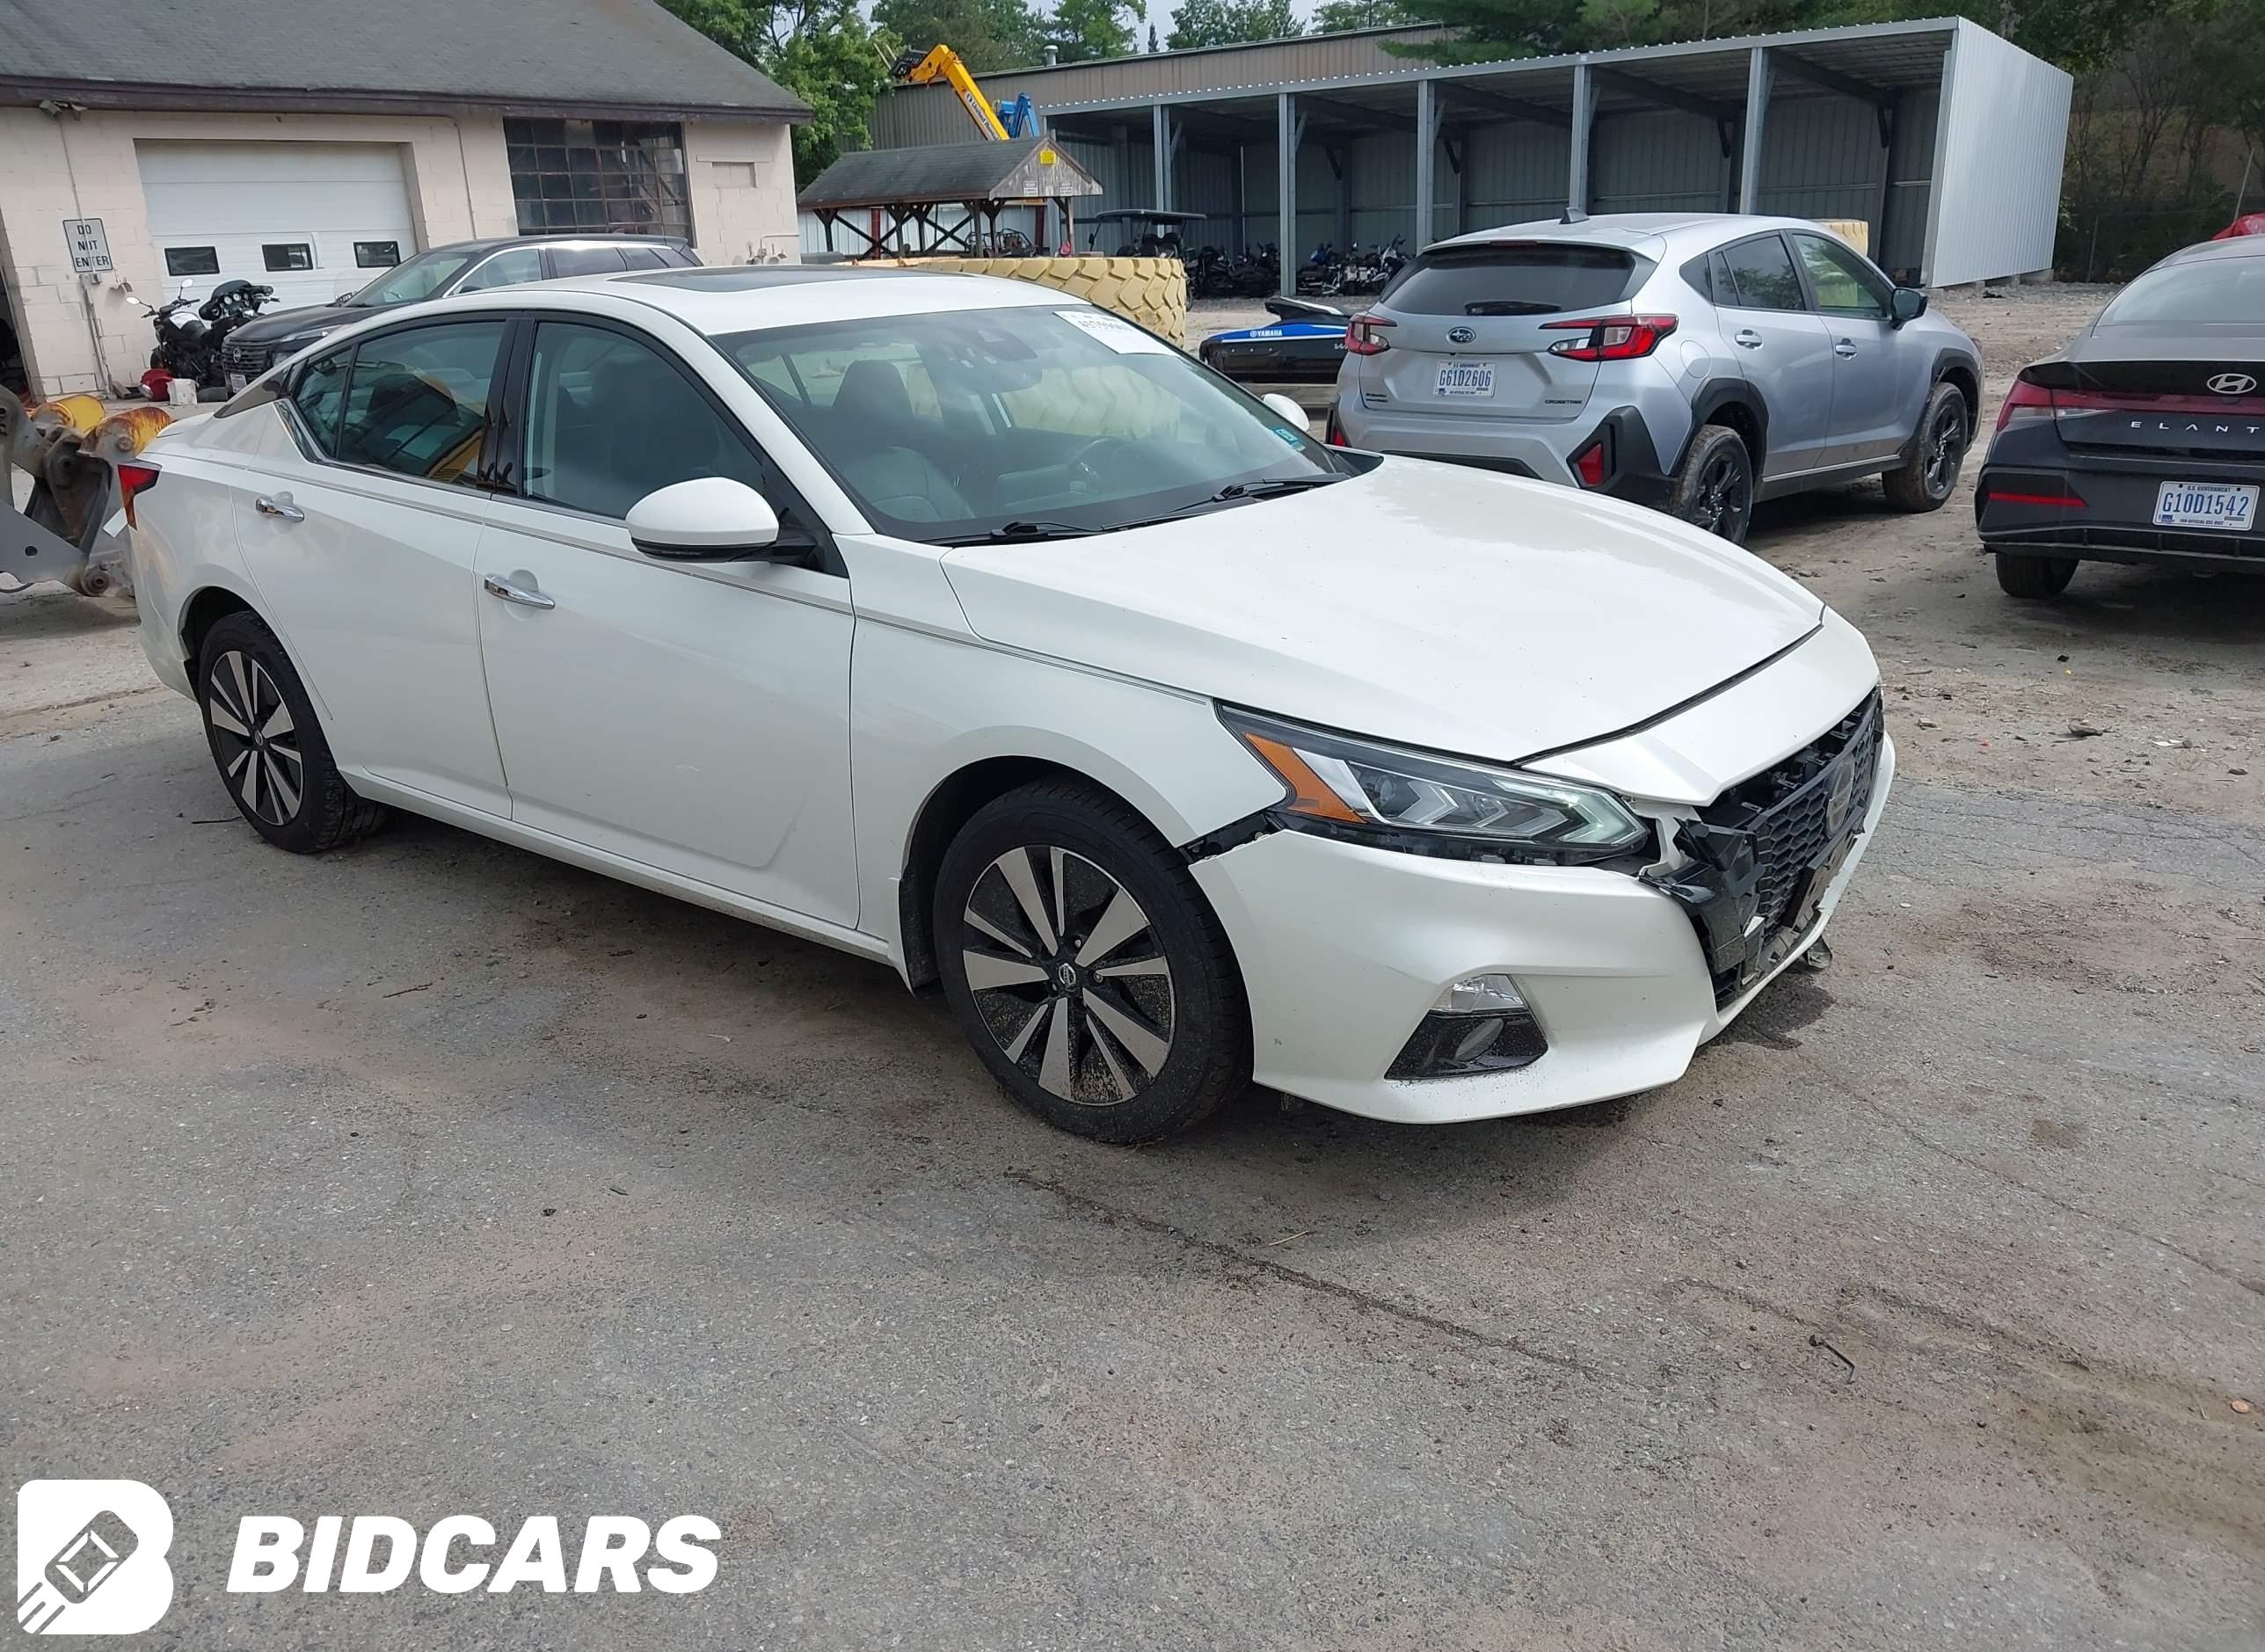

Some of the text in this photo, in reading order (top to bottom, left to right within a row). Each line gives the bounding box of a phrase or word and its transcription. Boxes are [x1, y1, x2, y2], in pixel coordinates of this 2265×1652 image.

[77, 224, 91, 235] DO
[76, 255, 109, 267] ENTER
[1439, 369, 1492, 387] G61D2606
[2163, 492, 2249, 516] G10D1542
